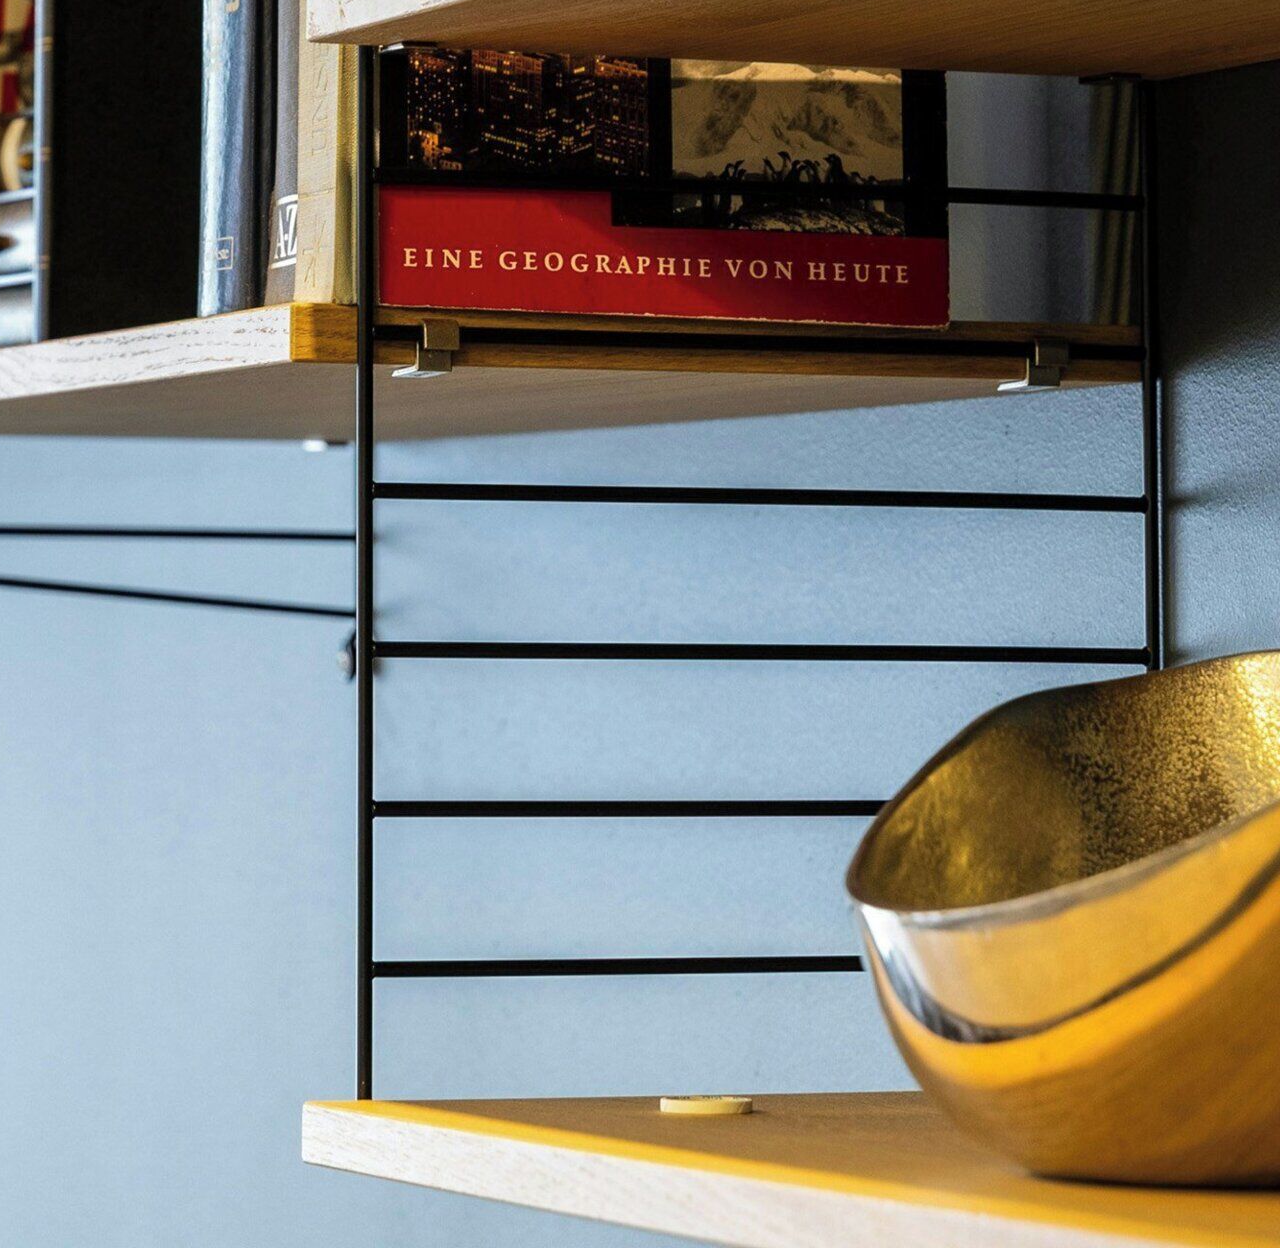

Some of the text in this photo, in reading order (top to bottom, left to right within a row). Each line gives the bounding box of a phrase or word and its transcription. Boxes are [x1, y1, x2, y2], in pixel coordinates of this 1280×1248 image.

[403, 248, 910, 285] EINE GEOGRAPHIE VON HEUTE
